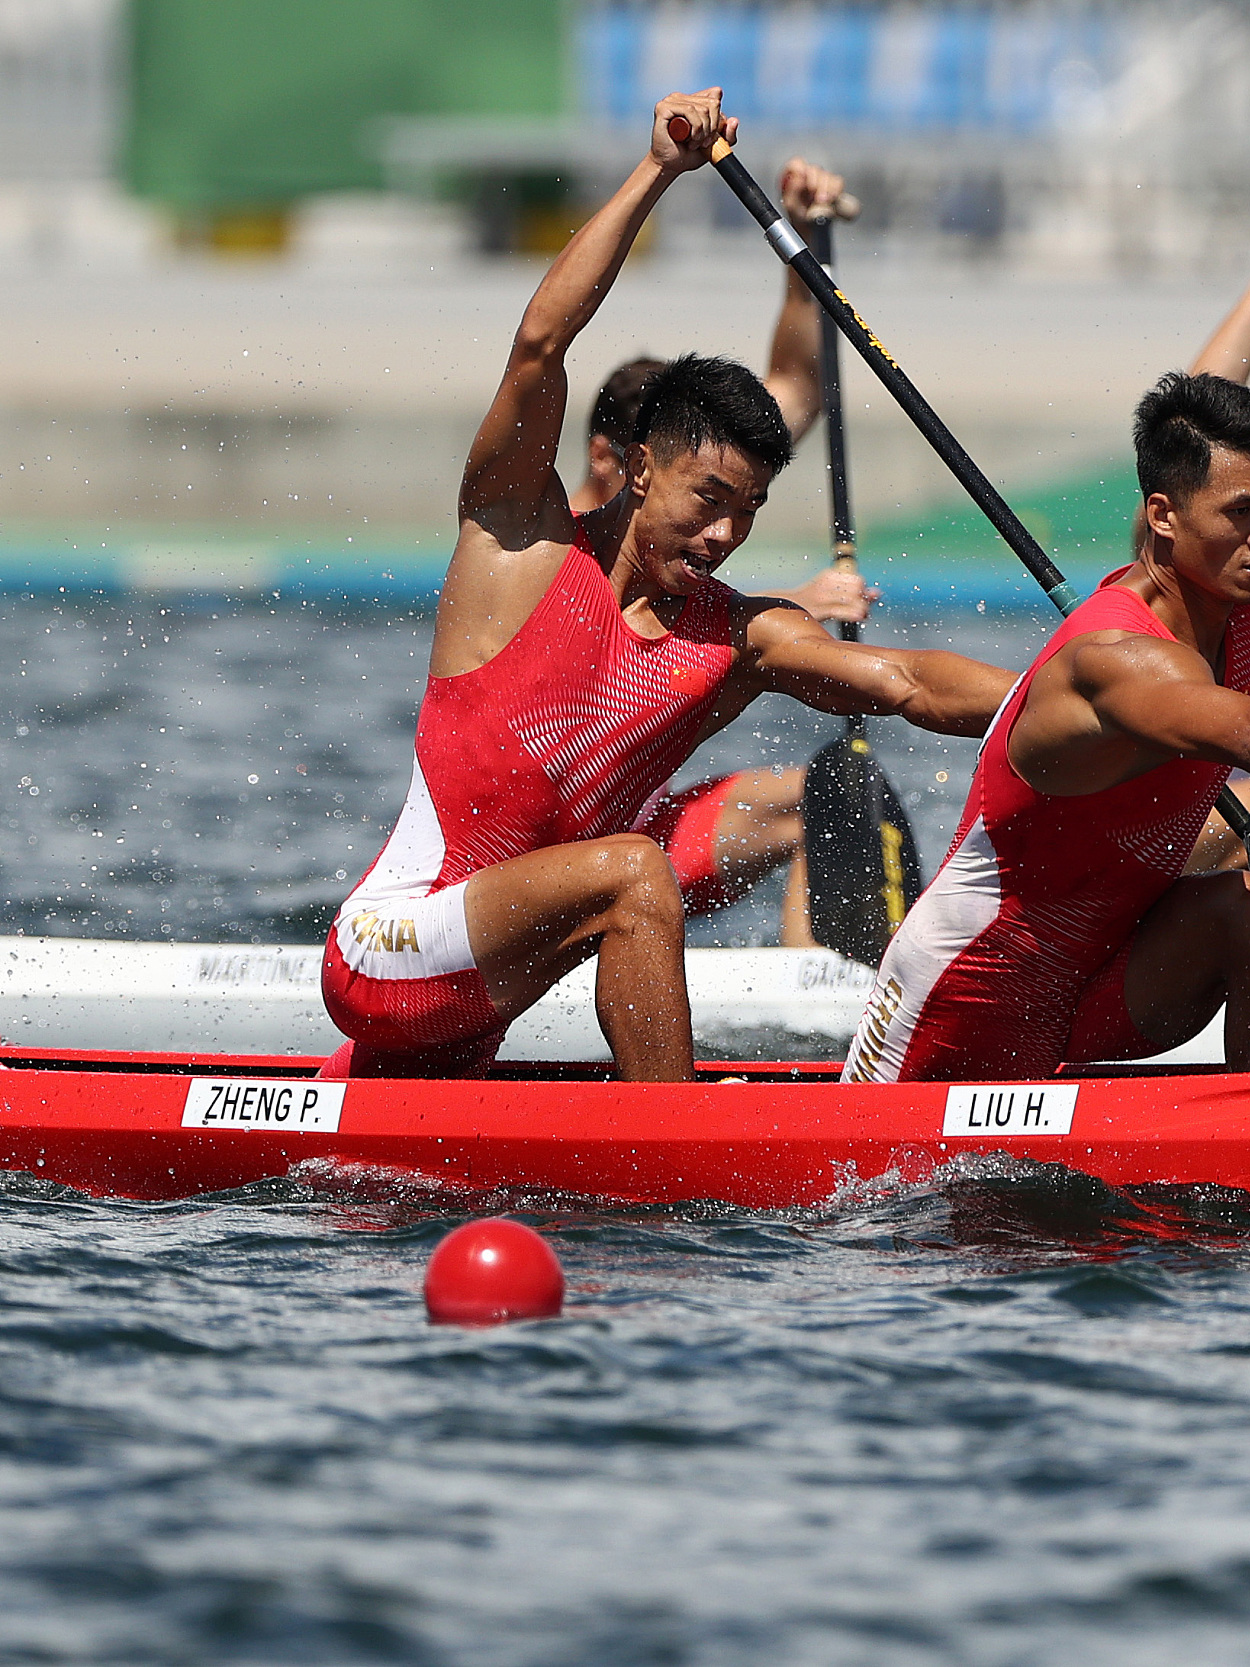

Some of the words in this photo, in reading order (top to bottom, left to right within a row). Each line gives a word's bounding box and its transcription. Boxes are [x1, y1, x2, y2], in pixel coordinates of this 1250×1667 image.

[204, 1086, 293, 1122] ZHENG
[299, 1088, 320, 1123] P.
[968, 1092, 1015, 1127] LIU
[1023, 1092, 1049, 1126] H.
